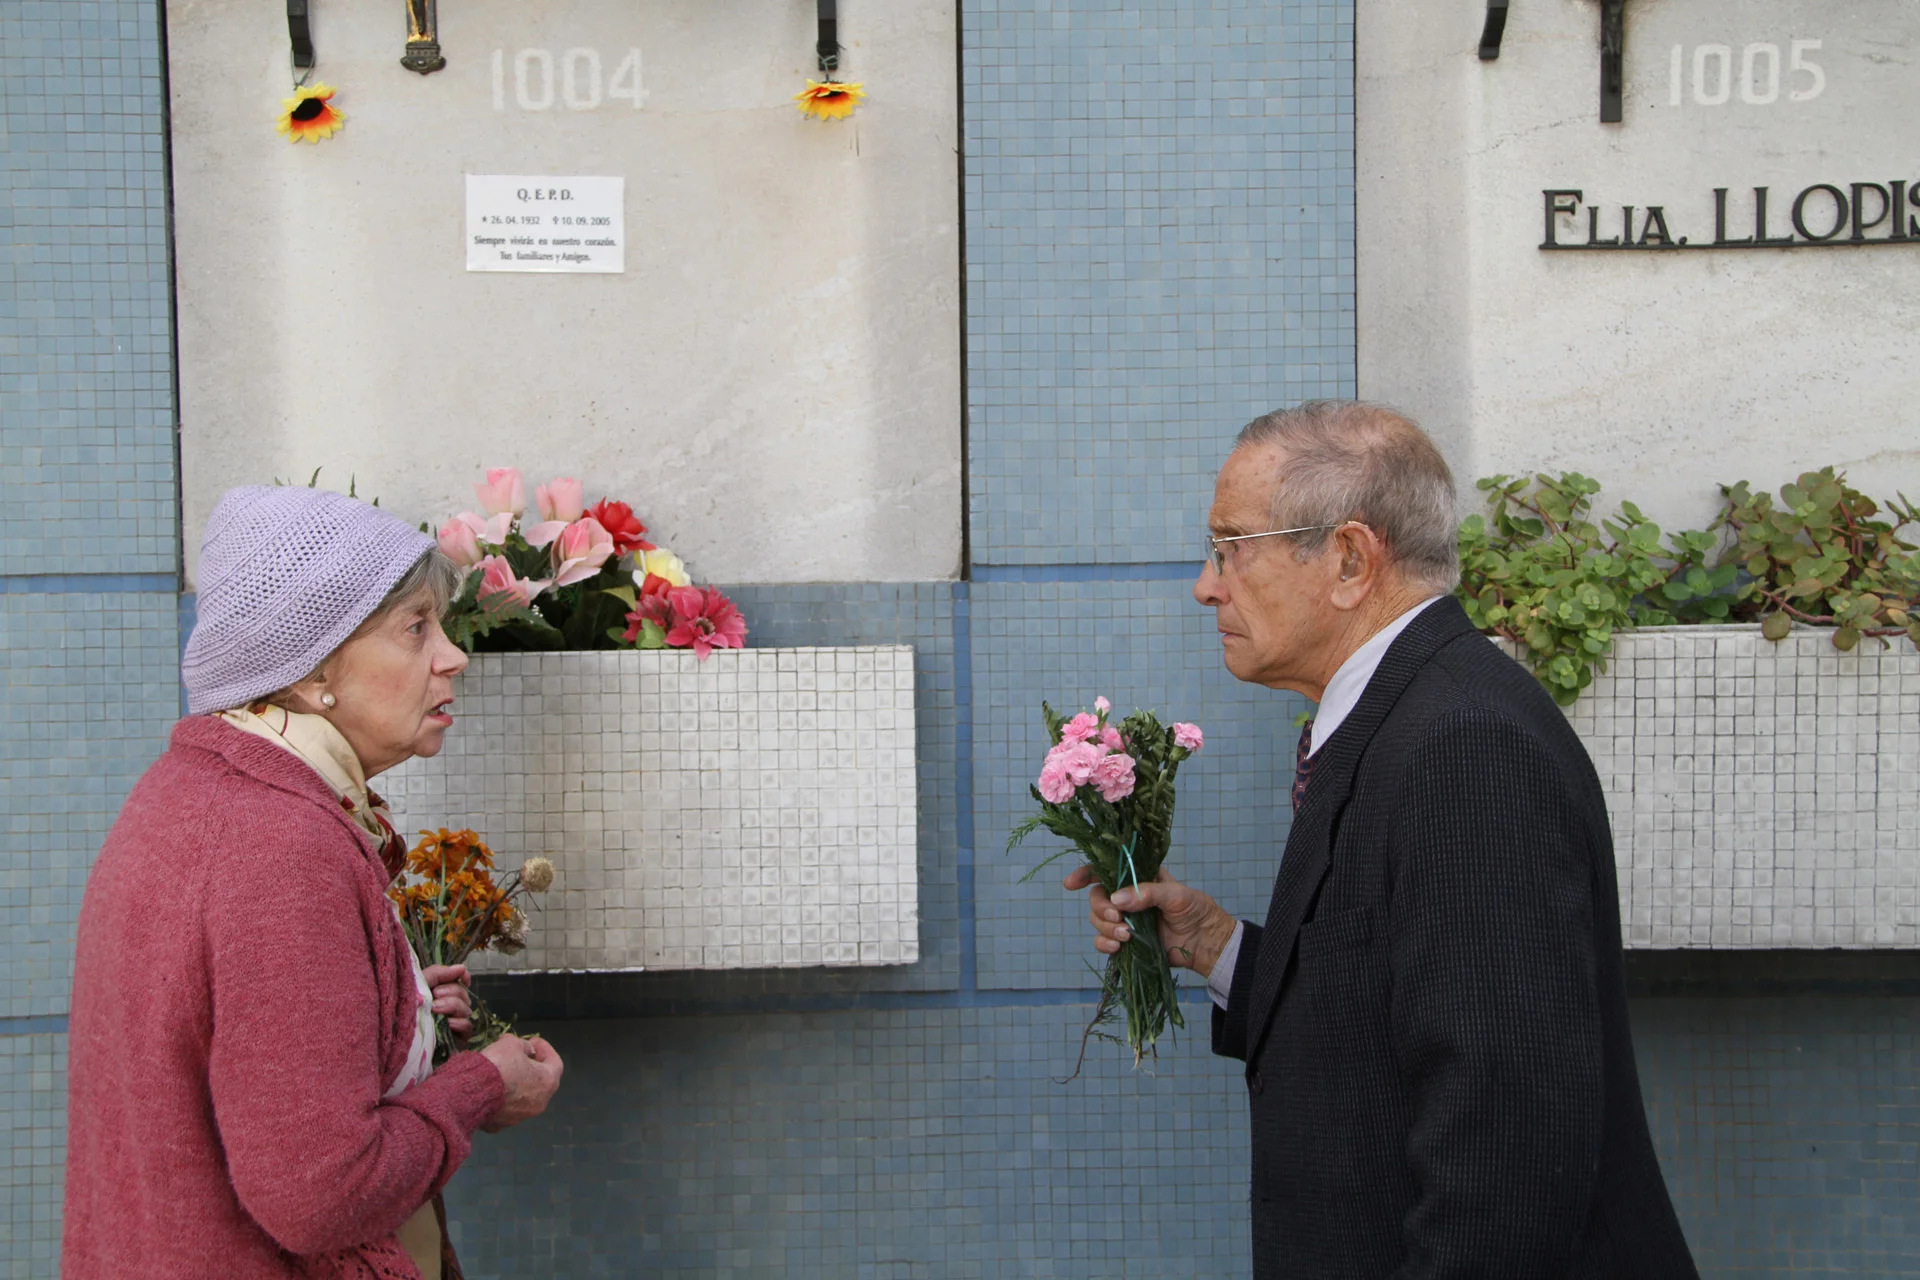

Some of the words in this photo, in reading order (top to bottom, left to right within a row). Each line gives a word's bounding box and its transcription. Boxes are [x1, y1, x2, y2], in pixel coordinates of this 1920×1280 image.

[492, 47, 650, 111] 1004
[1669, 39, 1826, 106] 1005
[474, 235, 505, 247] Siempre
[538, 238, 548, 246] en
[552, 238, 581, 247] nuestro
[500, 251, 512, 261] Tus
